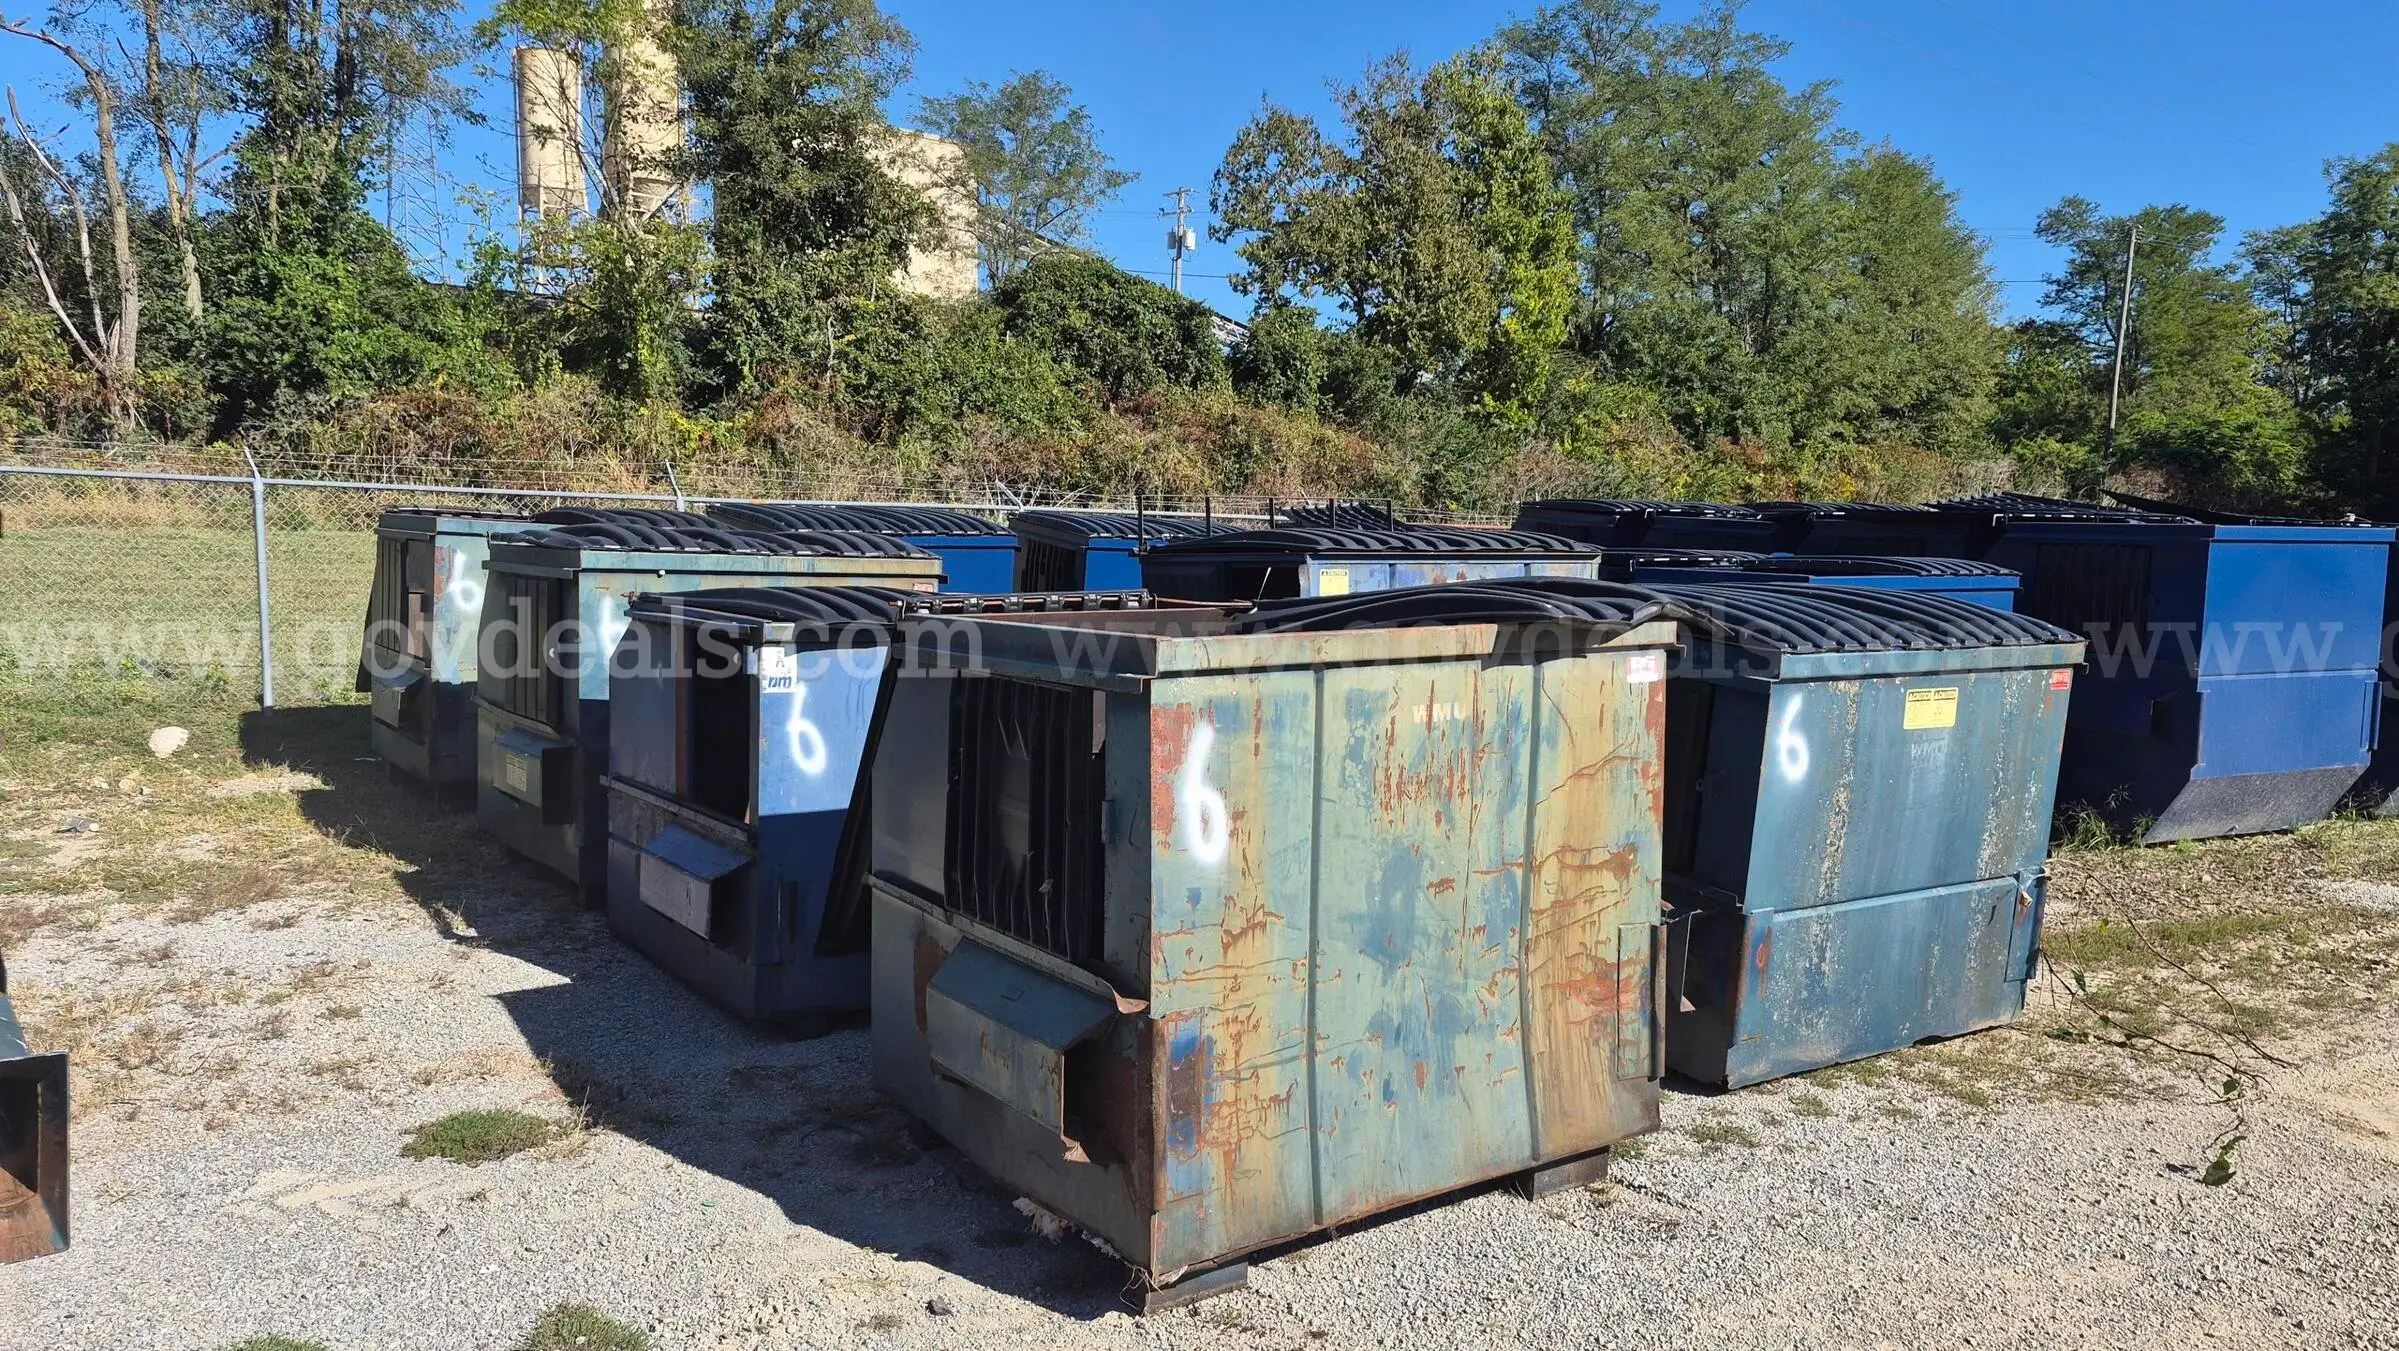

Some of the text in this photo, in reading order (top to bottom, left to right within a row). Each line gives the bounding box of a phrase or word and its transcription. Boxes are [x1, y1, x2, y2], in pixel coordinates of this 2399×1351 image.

[448, 550, 482, 612] 6
[786, 681, 826, 775] 6
[1777, 692, 1810, 784] 6
[1180, 721, 1229, 863] 6
